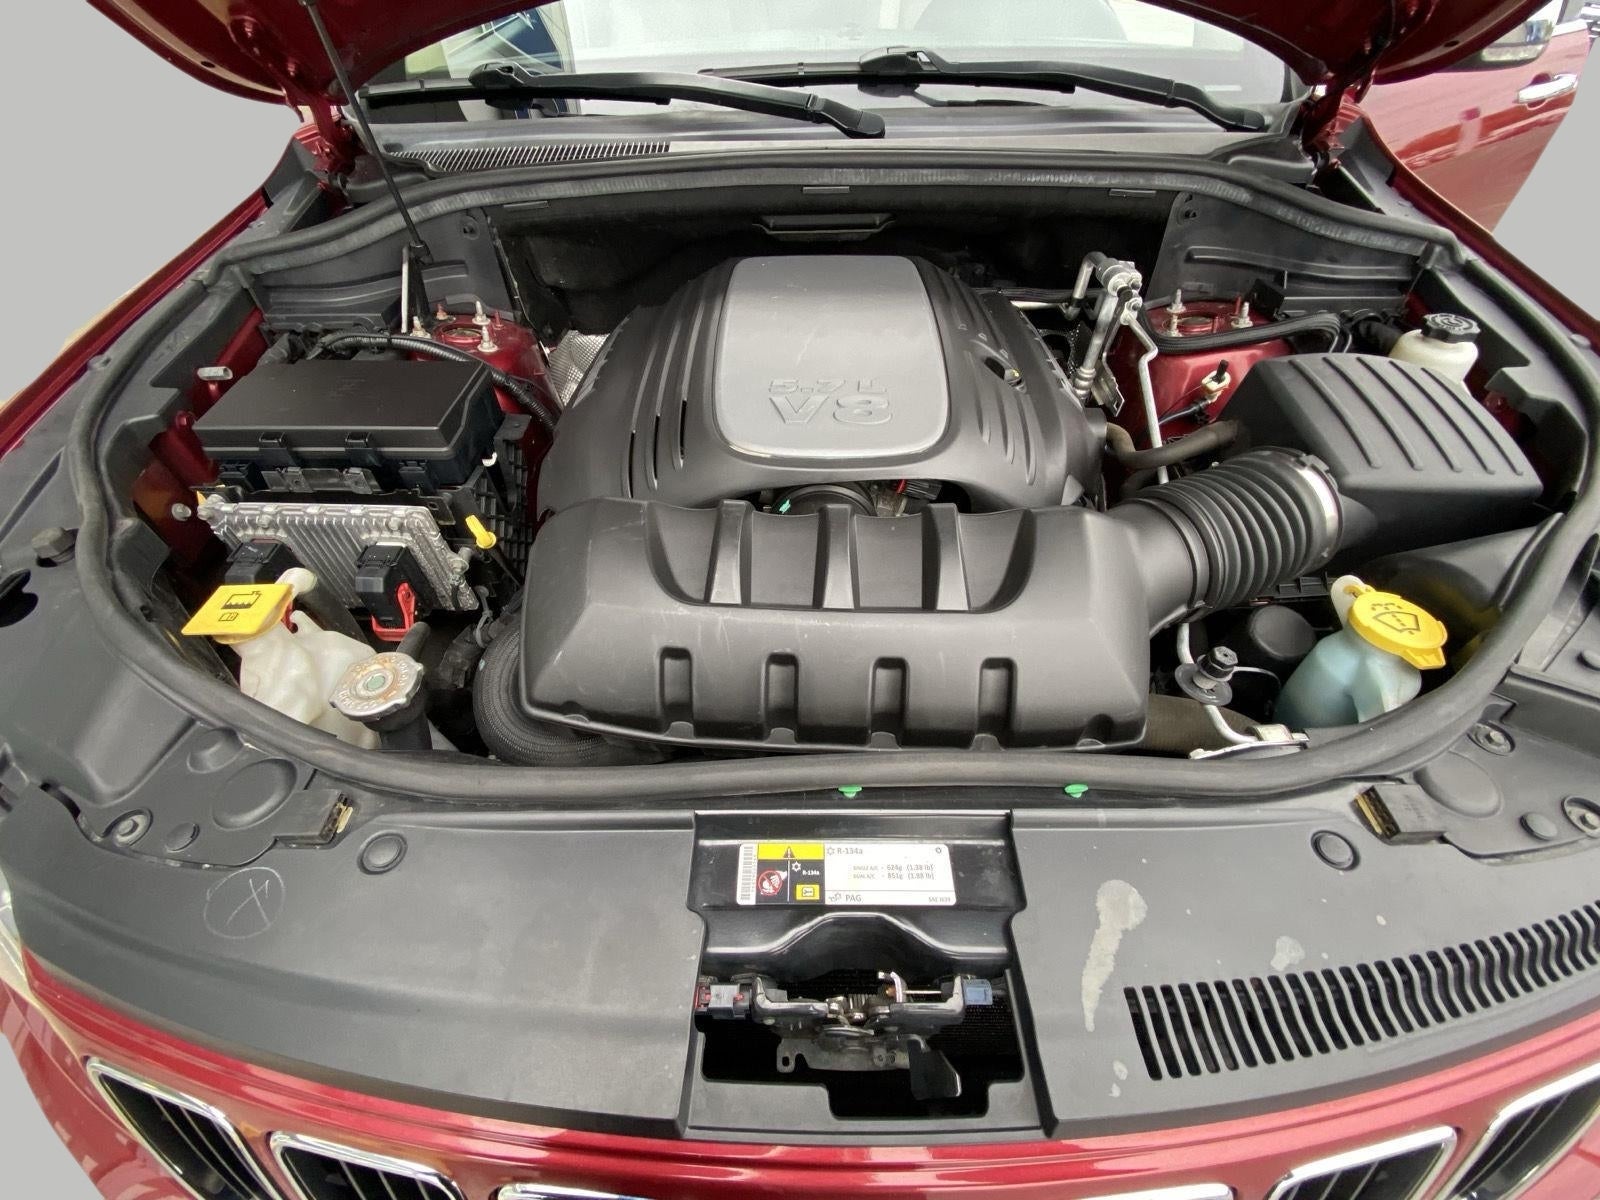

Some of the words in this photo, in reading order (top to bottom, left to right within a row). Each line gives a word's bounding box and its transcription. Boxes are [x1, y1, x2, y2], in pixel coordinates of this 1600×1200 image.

[769, 396, 893, 424] V8
[837, 847, 863, 855] R-134a
[845, 894, 862, 902] PAG
